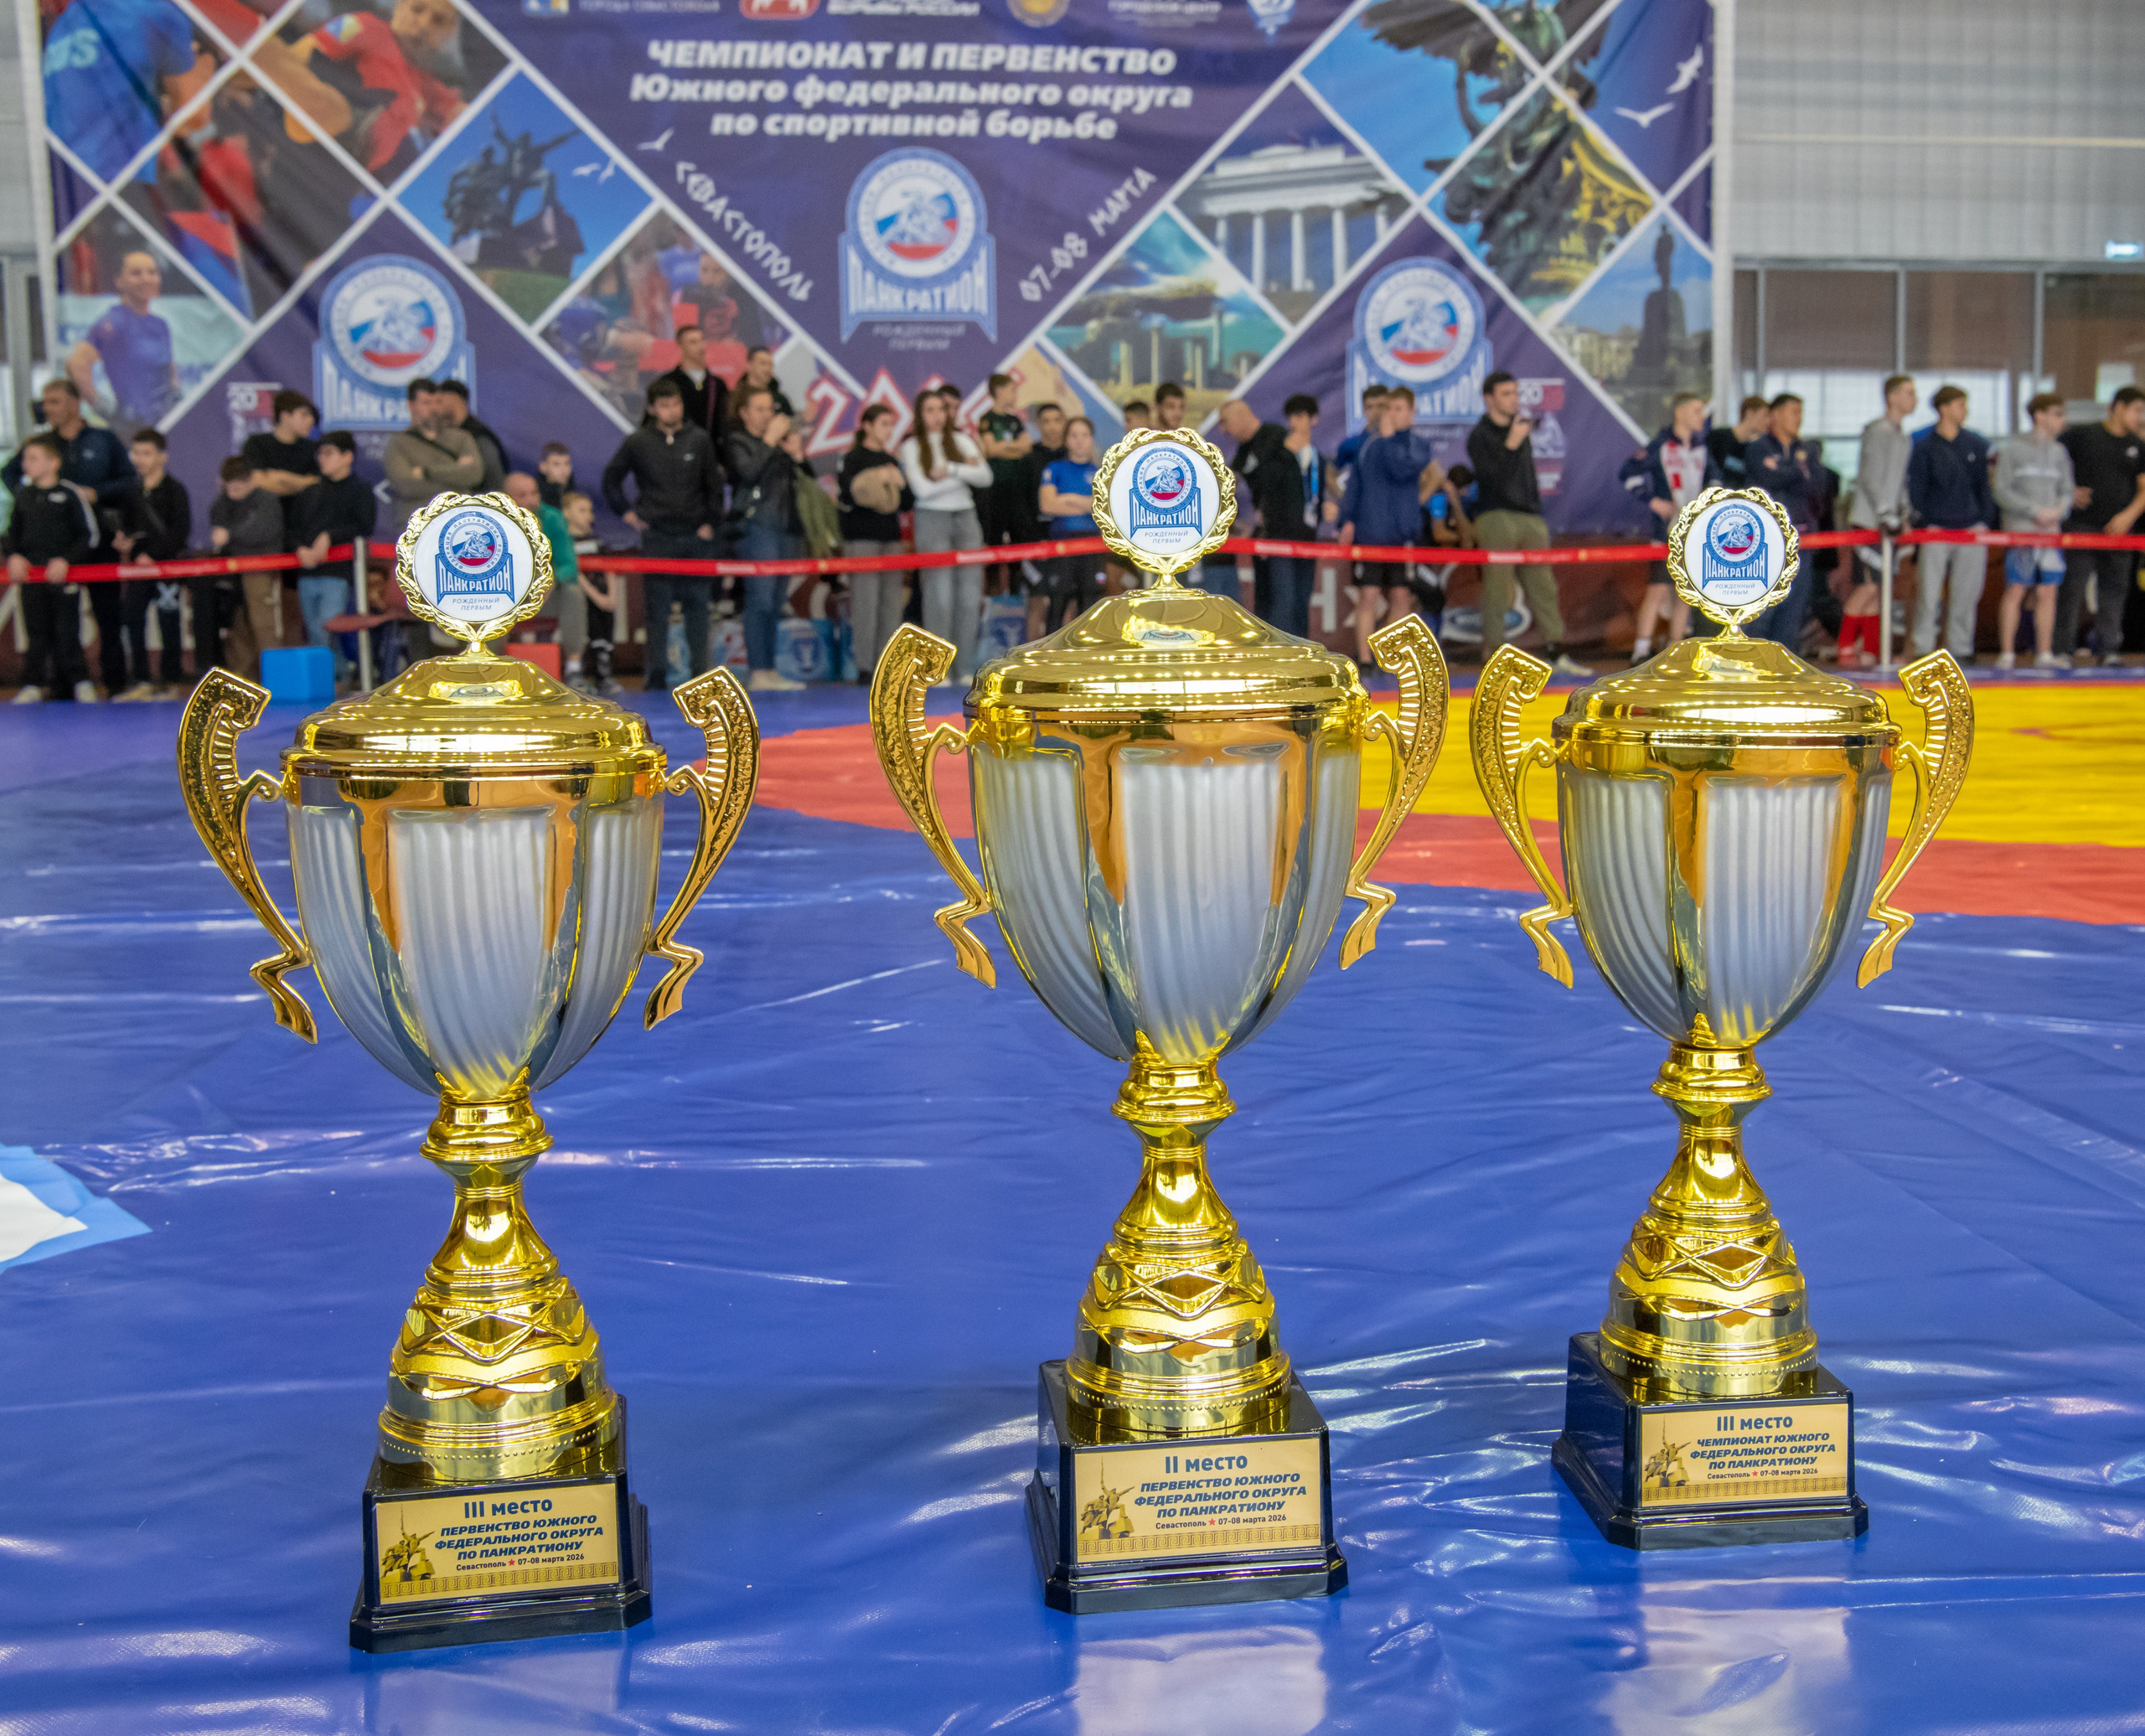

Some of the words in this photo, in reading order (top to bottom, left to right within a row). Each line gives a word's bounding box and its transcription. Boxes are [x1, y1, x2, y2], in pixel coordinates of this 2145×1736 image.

[648, 40, 894, 69] ЧЕМПИОНАТ
[897, 43, 927, 70] И
[931, 44, 1177, 75] ПЕРВЕНСТВО
[630, 74, 788, 101] Южного
[793, 74, 1062, 110] федерального
[1067, 85, 1193, 114] округа
[711, 113, 758, 136] по
[762, 109, 980, 142] спортивной
[985, 109, 1118, 145] борьбе
[1019, 231, 1088, 302] 07-08
[1088, 166, 1157, 237] МАРТА
[848, 245, 988, 315] ПАНКРАТИОН
[1146, 453, 1189, 473] ПАНКРАТИОНА
[1140, 467, 1155, 504] ФЕДЕРАЦИЯ
[1176, 478, 1191, 504] РОССИИ
[1133, 494, 1199, 528] ПАНКРАТИОН
[453, 518, 500, 539] ПАНКРАТИОНА
[1712, 522, 1726, 558] ФЕДЕРАЦИЯ
[1720, 510, 1758, 529] ПАНКРАТИОНА
[1745, 534, 1760, 557] РОССИИ
[445, 531, 463, 569] ФЕДЕРАЦИЯ
[486, 544, 502, 569] РОССИИ
[1705, 548, 1765, 579] ПАНКРАТИОН
[440, 564, 511, 592] ПАНКРАТИОН
[1717, 1416, 1734, 1431] III
[1739, 1416, 1793, 1430] место
[1697, 1435, 1772, 1447] ЧЕМПИОНАТ
[1774, 1433, 1830, 1443] ЮЖНОГО
[1690, 1447, 1787, 1460] ФЕДЕРАЛЬНОГО
[1789, 1444, 1836, 1454] ОКРУГА
[1166, 1456, 1178, 1474] II
[1185, 1454, 1248, 1472] место
[1708, 1461, 1727, 1470] ПО
[1728, 1456, 1817, 1469] ПАНКРАТИОНУ
[1781, 1469, 1801, 1477] марта
[1140, 1477, 1232, 1493] ПЕРВЕНСТВО
[1234, 1473, 1300, 1486] ЮЖНОГО
[1134, 1489, 1249, 1506] ФЕДЕРАЛЬНОГО
[1252, 1485, 1306, 1498] ОКРУГА
[464, 1501, 484, 1518] III
[492, 1499, 552, 1516] место
[1157, 1508, 1177, 1518] ПО
[1179, 1501, 1285, 1516] ПАНКРАТИОНУ
[440, 1520, 530, 1537] ПЕРВЕНСТВО
[533, 1515, 597, 1527] ЮЖНОГО
[1155, 1520, 1207, 1530] Севастополь
[1218, 1516, 1241, 1525] 07-08
[1243, 1516, 1266, 1524] марта
[1268, 1514, 1287, 1522] 2026
[434, 1531, 548, 1550] ФЕДЕРАЛЬНОГО
[550, 1527, 604, 1540] ОКРУГА
[457, 1551, 477, 1561] ПО
[479, 1541, 583, 1559] ПАНКРАТИОНУ
[456, 1560, 507, 1571] Севастополь
[518, 1557, 540, 1565] 07-08
[541, 1555, 564, 1564] марта
[566, 1553, 585, 1562] 2026
